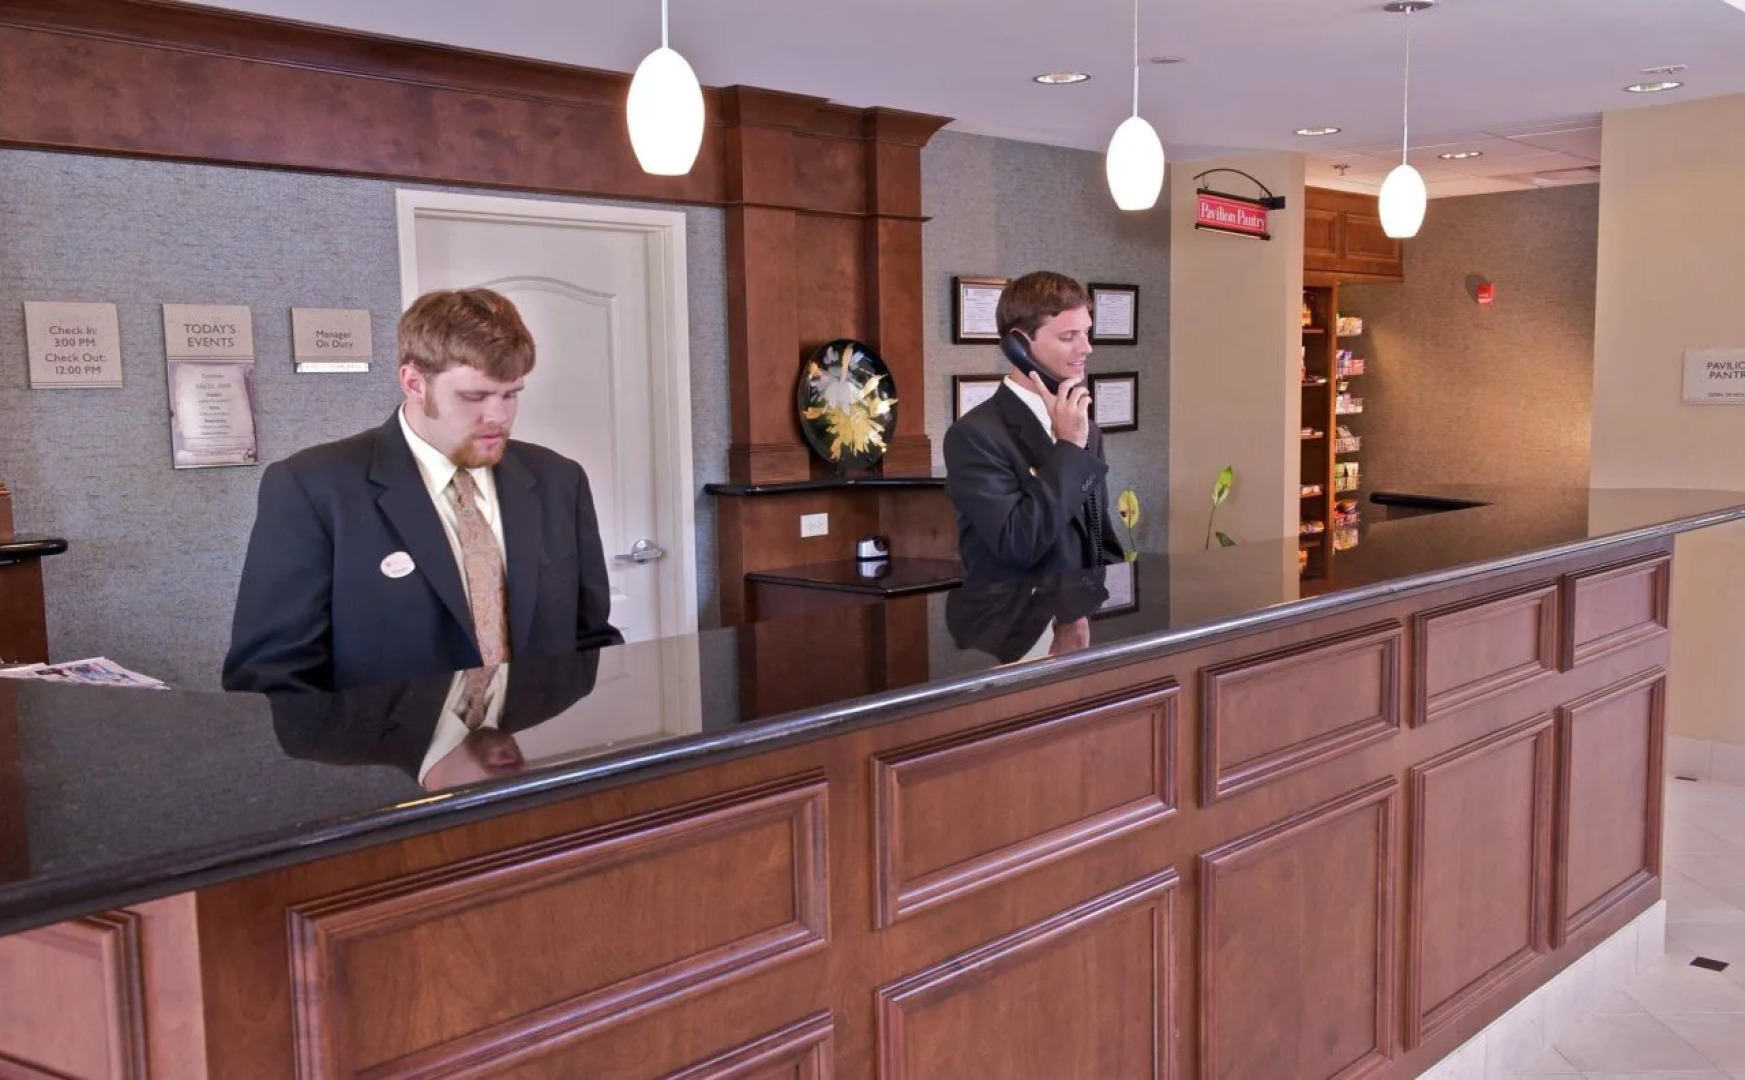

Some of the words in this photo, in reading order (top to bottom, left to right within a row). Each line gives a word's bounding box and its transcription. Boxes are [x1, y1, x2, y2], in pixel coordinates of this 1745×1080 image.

[1201, 202, 1236, 223] Pavilion
[1237, 209, 1265, 231] Pantry
[48, 325, 83, 335] Check
[86, 326, 98, 335] In:
[183, 323, 236, 334] TODAY'S
[315, 330, 351, 340] Manager
[54, 337, 76, 347] 3:00
[78, 338, 96, 347] PM
[187, 337, 234, 348] EVENTS
[315, 340, 329, 349] On
[332, 340, 353, 350] Duty
[44, 353, 80, 362] Check
[82, 352, 107, 362] Out:
[55, 366, 81, 375] 12:00
[84, 366, 102, 375] PM
